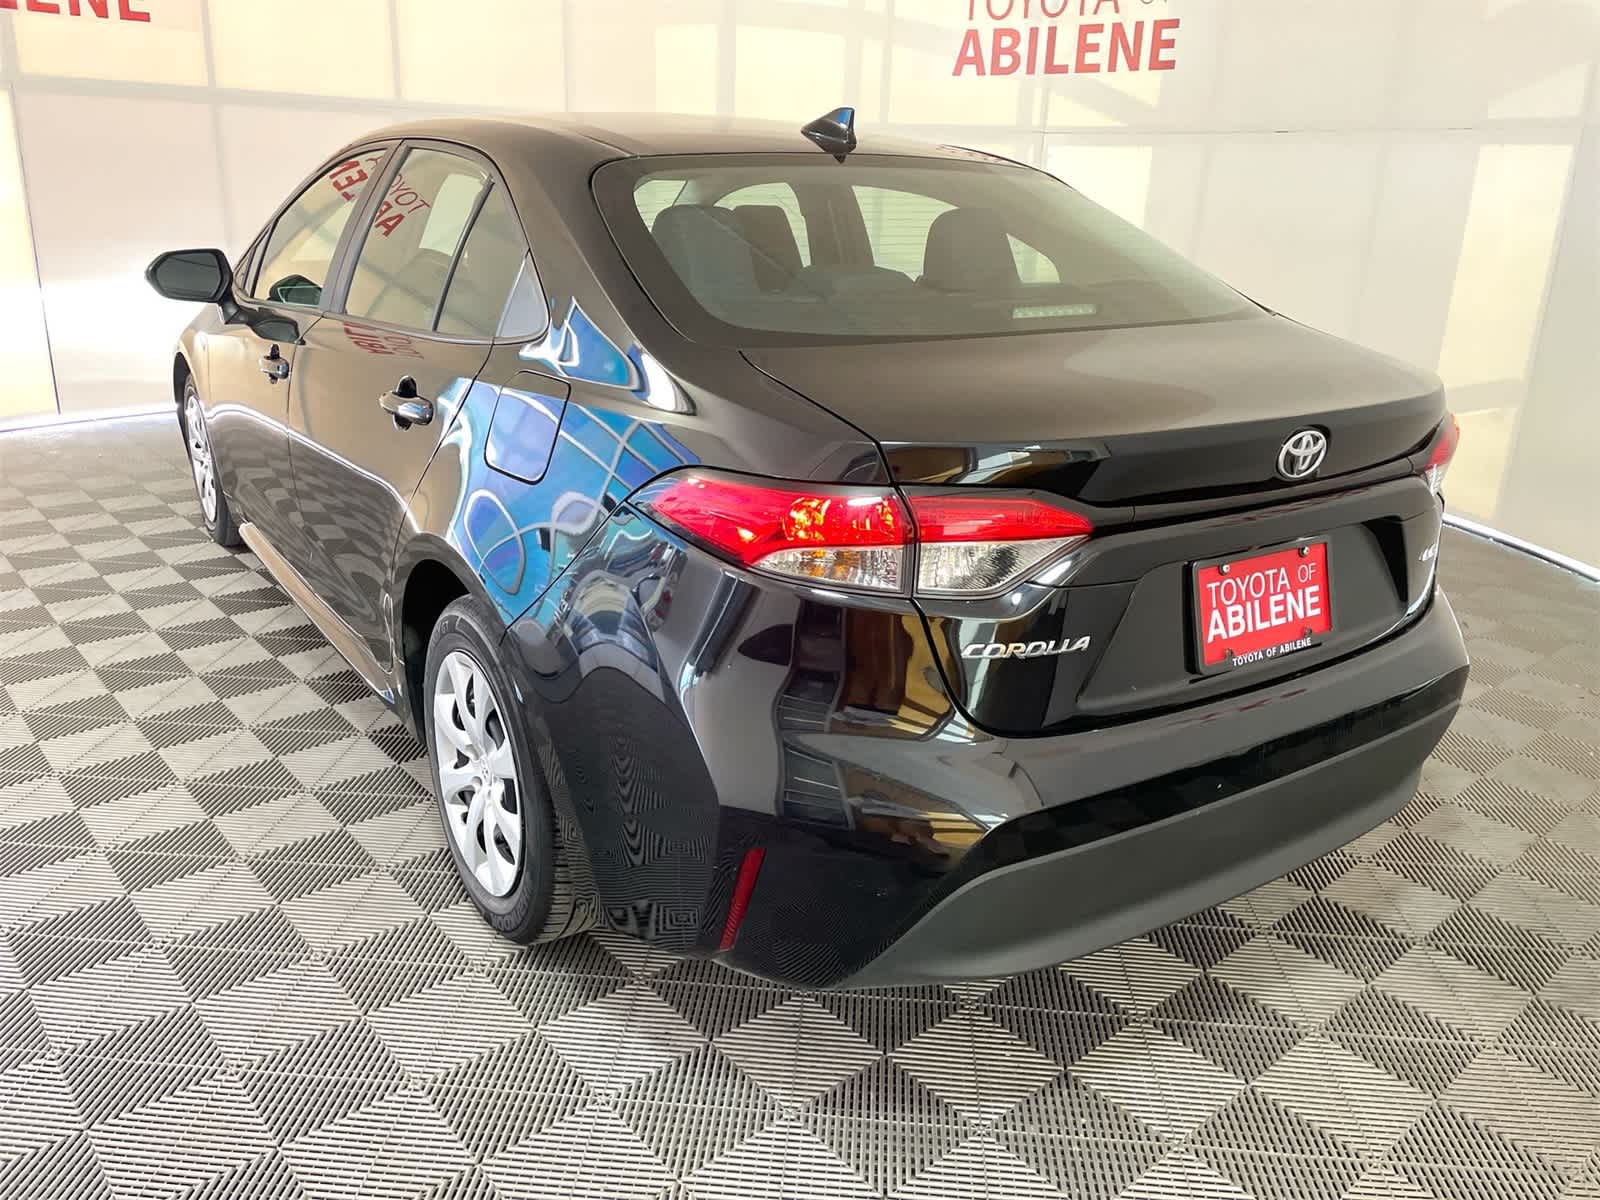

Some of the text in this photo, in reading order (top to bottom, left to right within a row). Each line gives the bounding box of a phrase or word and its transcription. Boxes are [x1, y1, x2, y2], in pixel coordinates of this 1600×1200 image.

[952, 18, 1180, 76] ABILENE
[1207, 562, 1317, 608] TOYOTA OF
[1207, 585, 1321, 644] ABILENE
[961, 635, 1091, 660] COROLLA
[1232, 637, 1312, 667] TOYOTA OF ABILENE
